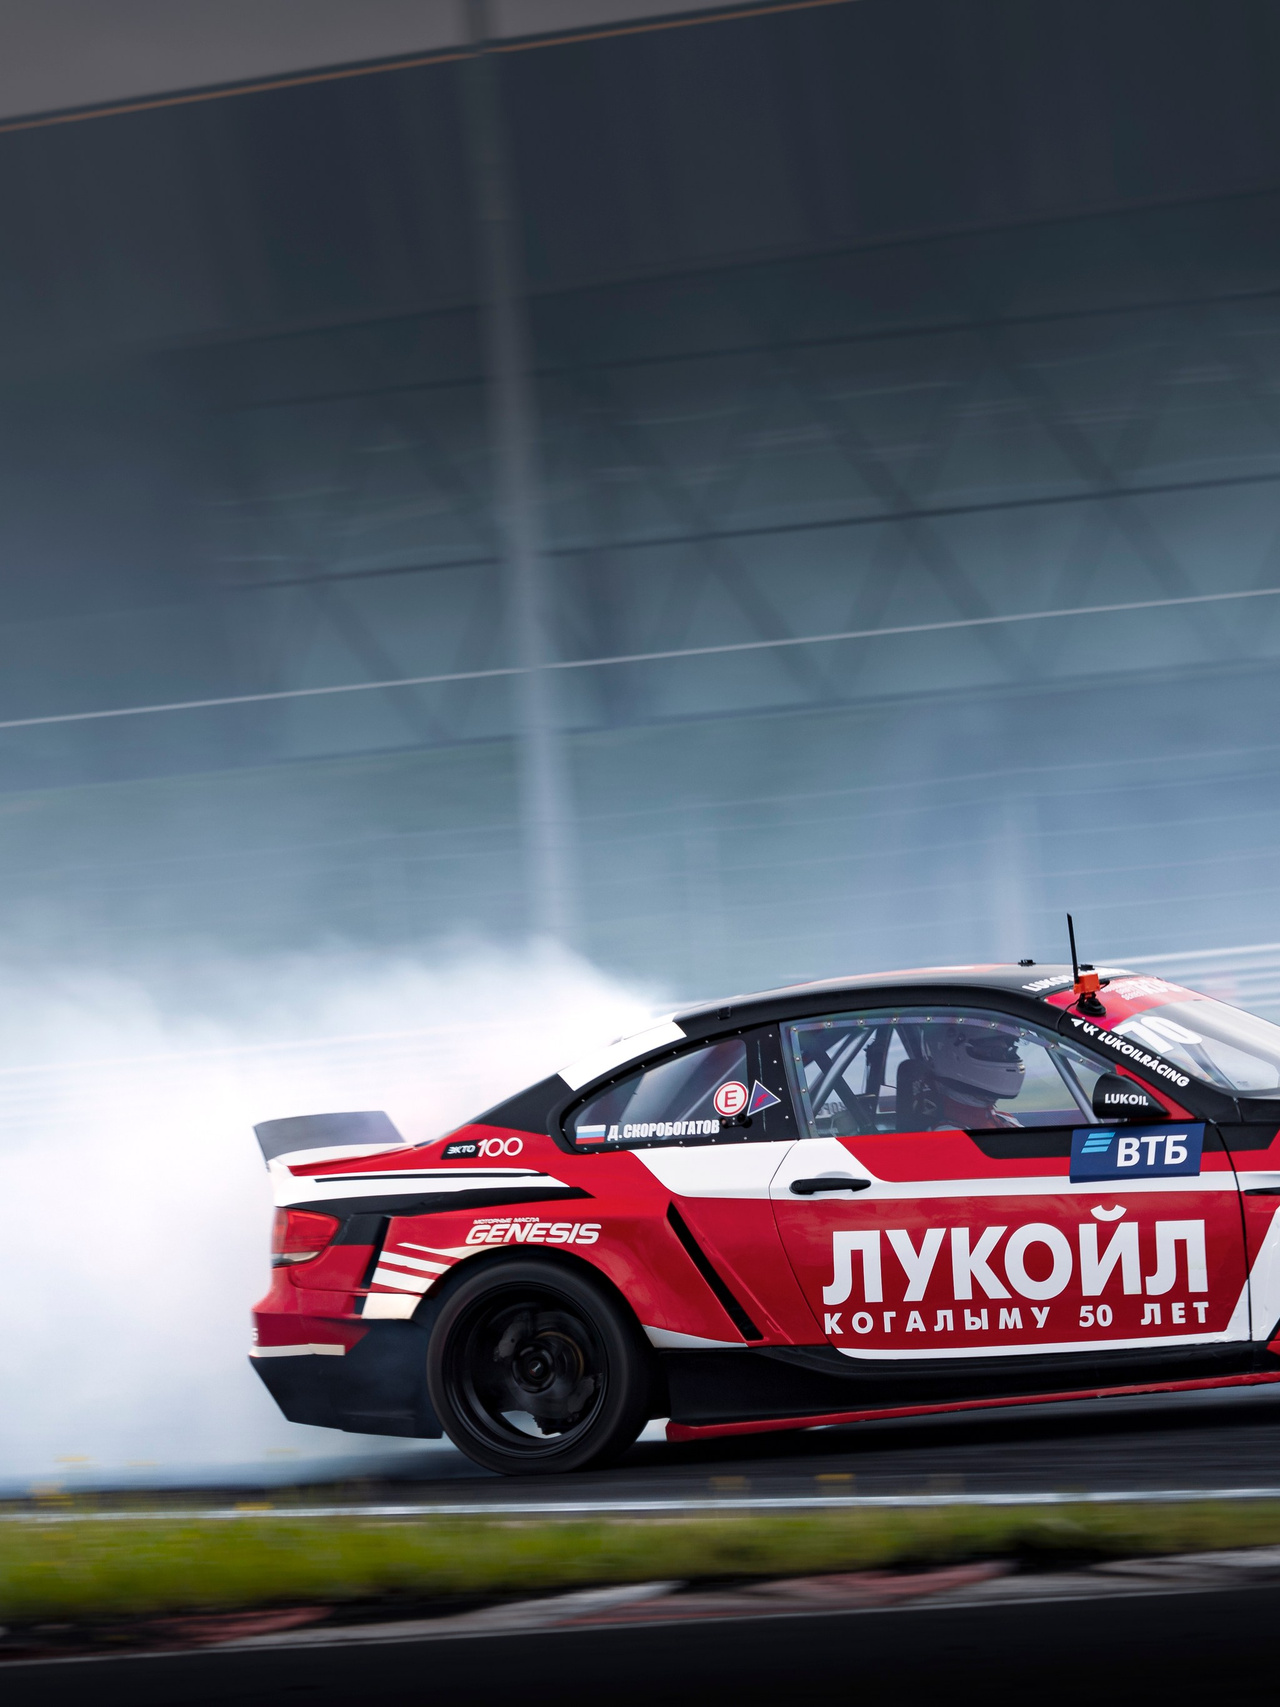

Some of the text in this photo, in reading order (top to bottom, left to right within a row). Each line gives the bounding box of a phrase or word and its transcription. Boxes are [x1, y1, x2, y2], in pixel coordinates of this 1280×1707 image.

[1111, 1016, 1203, 1054] 70
[1097, 1032, 1190, 1087] LUKOILRACING
[724, 1089, 738, 1108] E
[1105, 1093, 1149, 1106] LUKOIL
[607, 1119, 720, 1142] Д.СКОРОБОГАТОВ
[477, 1136, 524, 1158] 100
[1117, 1134, 1188, 1168] ВТБ
[465, 1222, 602, 1245] GENESIS
[822, 1204, 1209, 1306] ЛУКОЙЛ
[824, 1301, 1209, 1335] КОГАЛЫМУ 50 ЛЕТ
